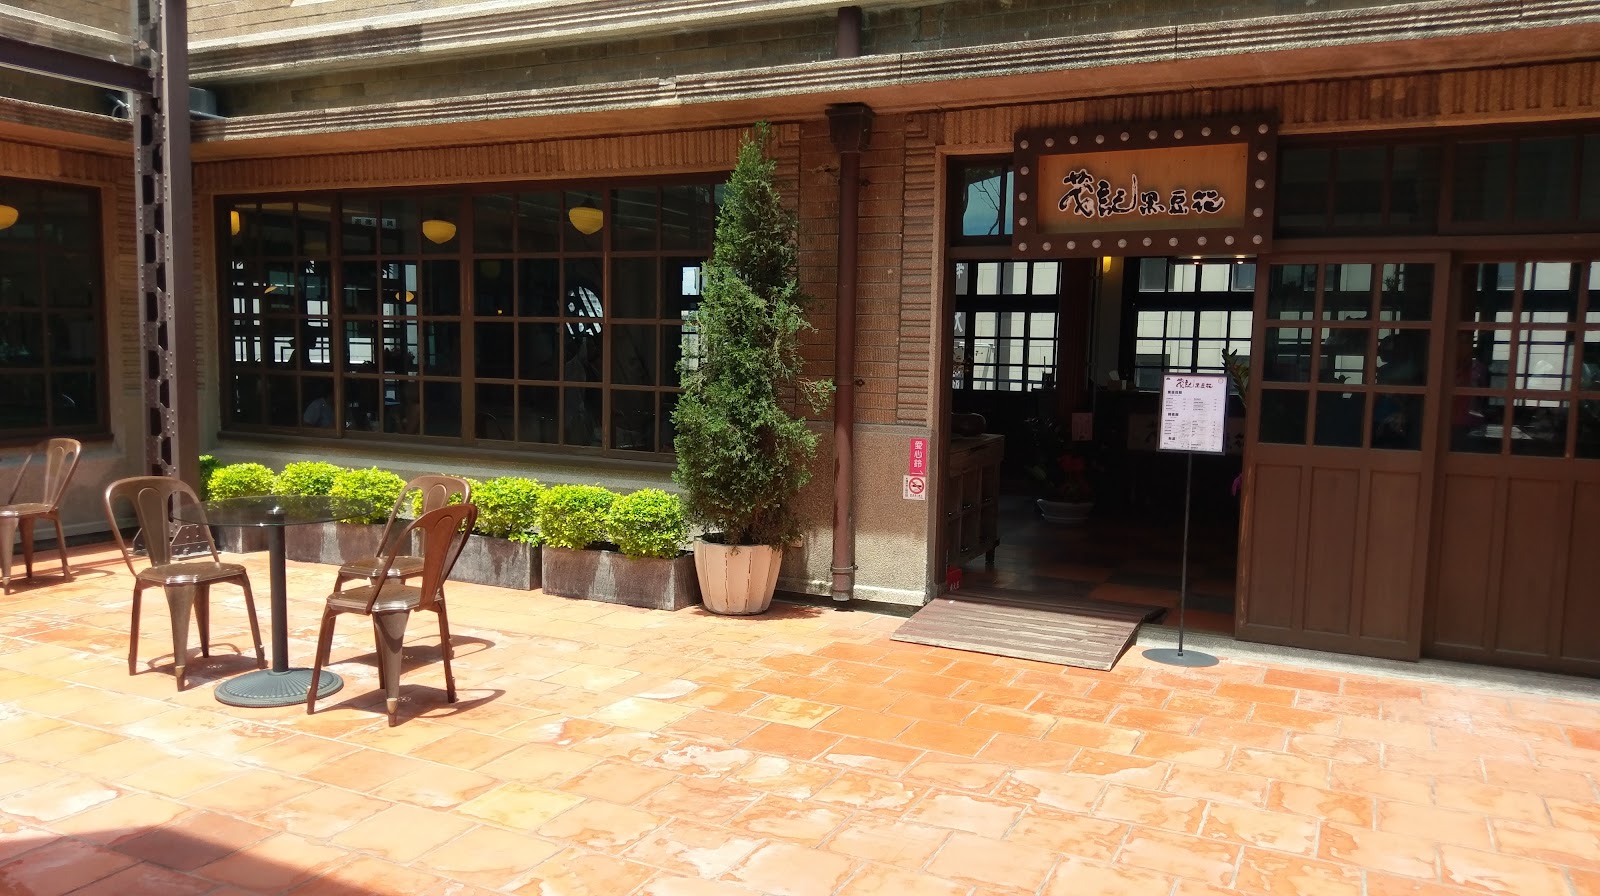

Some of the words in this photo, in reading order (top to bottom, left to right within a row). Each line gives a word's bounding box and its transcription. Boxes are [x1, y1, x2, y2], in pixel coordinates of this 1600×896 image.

[1058, 169, 1225, 218] 茂記黑豆花
[914, 441, 923, 468] 愛心鈴
